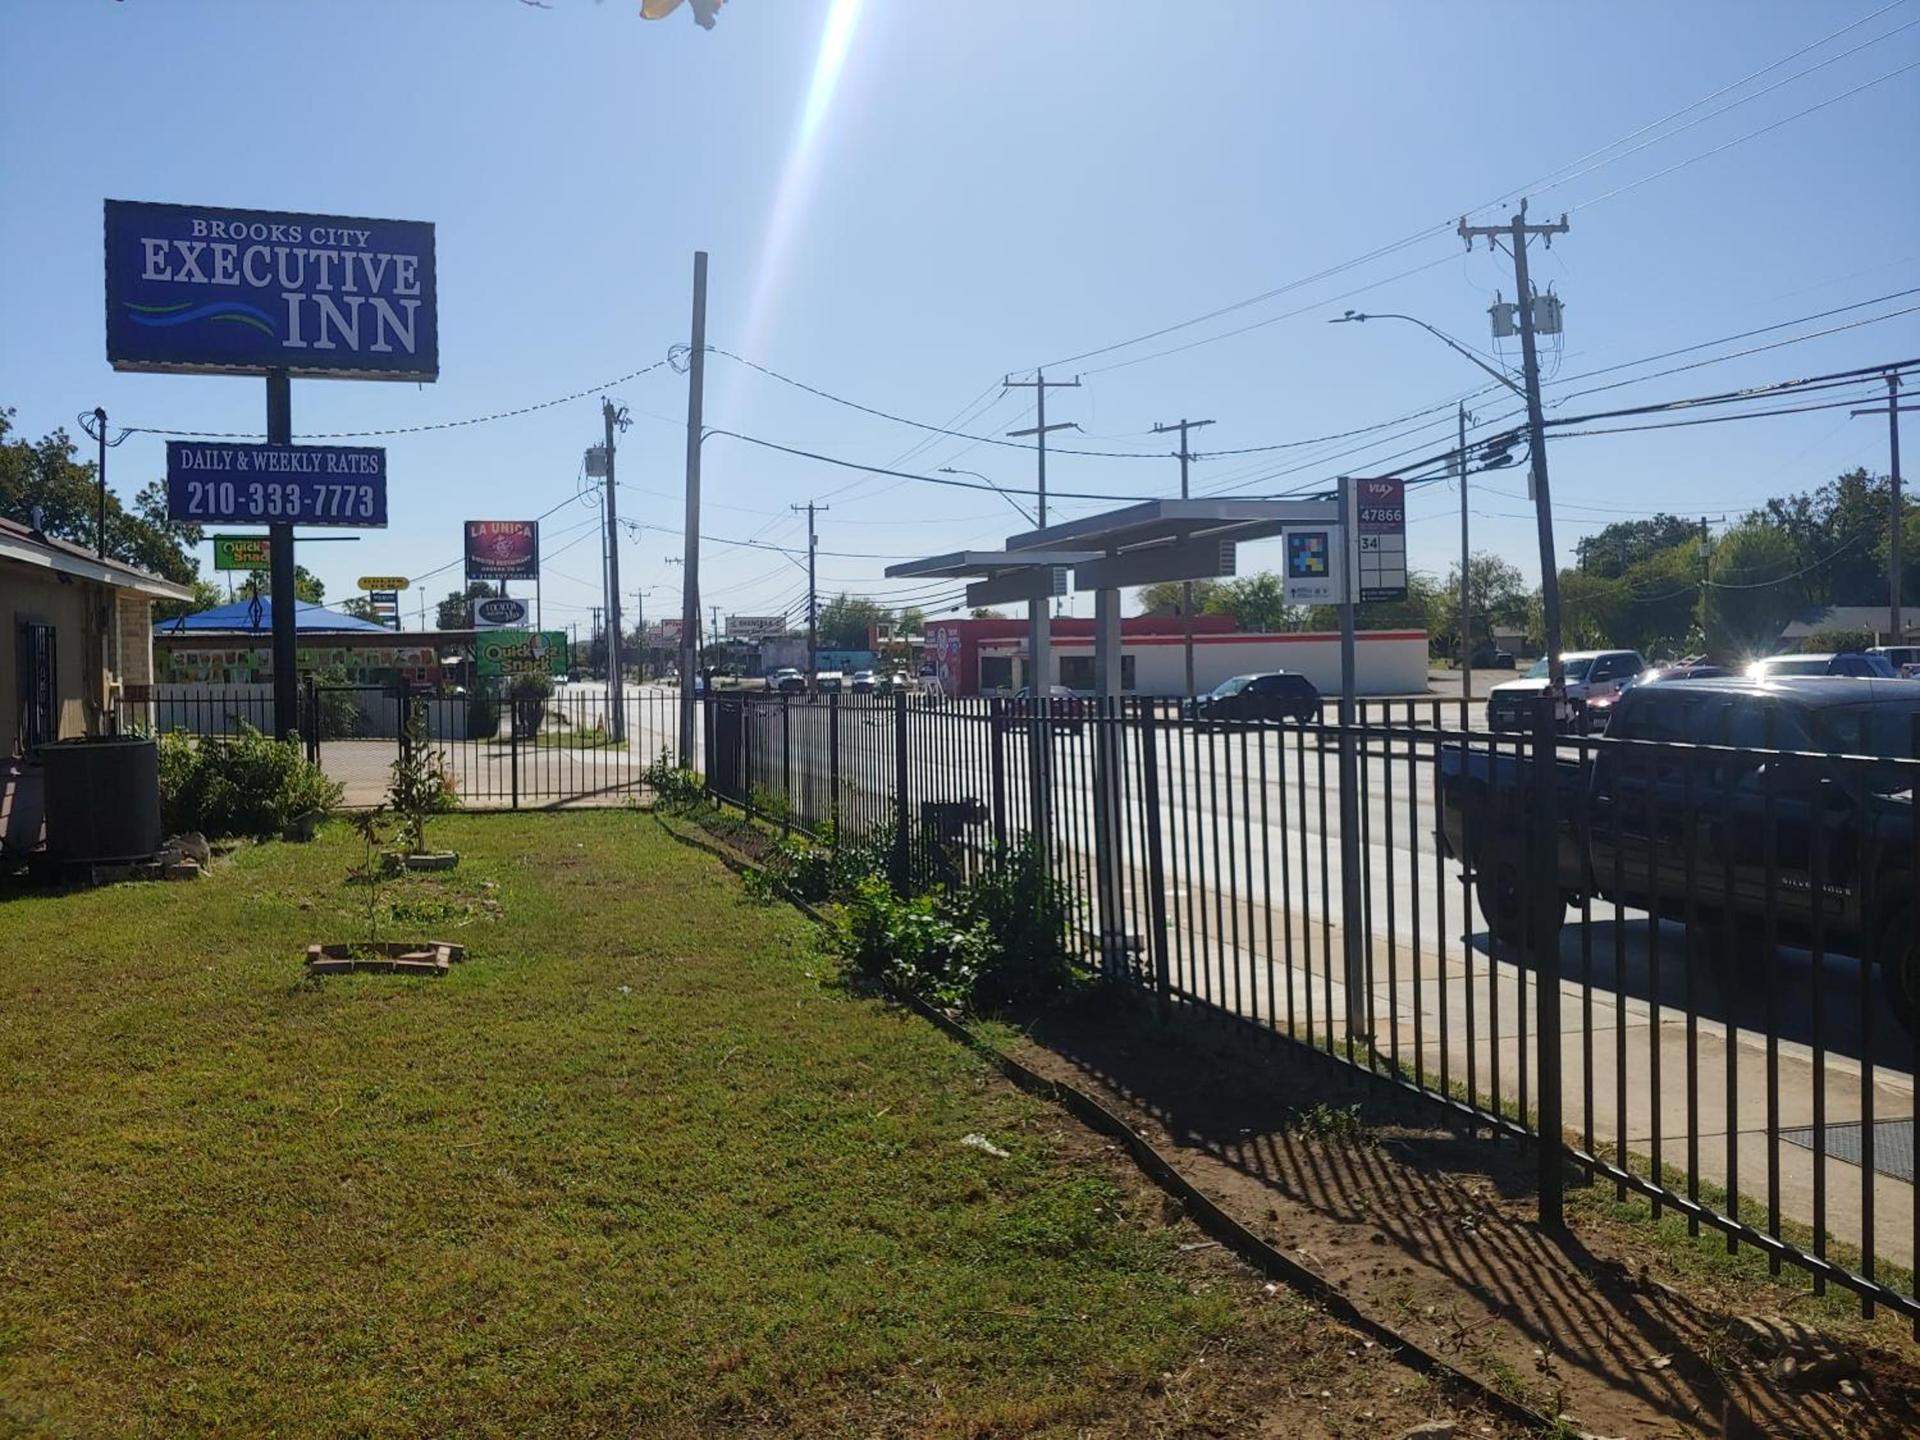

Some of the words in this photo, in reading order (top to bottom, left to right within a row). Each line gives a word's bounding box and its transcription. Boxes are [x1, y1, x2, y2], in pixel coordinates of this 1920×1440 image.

[192, 219, 303, 244] BROOKS
[309, 227, 371, 247] CITY
[140, 237, 421, 296] EXECUTIVE
[281, 292, 422, 354] INN
[181, 450, 233, 471] DAILY
[236, 453, 249, 471] &
[252, 452, 323, 473] WEEKLY
[326, 453, 379, 475] RATES
[1369, 483, 1386, 494] VIA
[188, 481, 374, 517] 210-333-7773
[1361, 509, 1403, 522] 47866
[471, 524, 488, 538] LA
[492, 522, 533, 538] UNICA
[223, 541, 263, 554] Quick
[1361, 538, 1378, 550] 34
[233, 551, 269, 562] Snac
[484, 644, 531, 662] Quick
